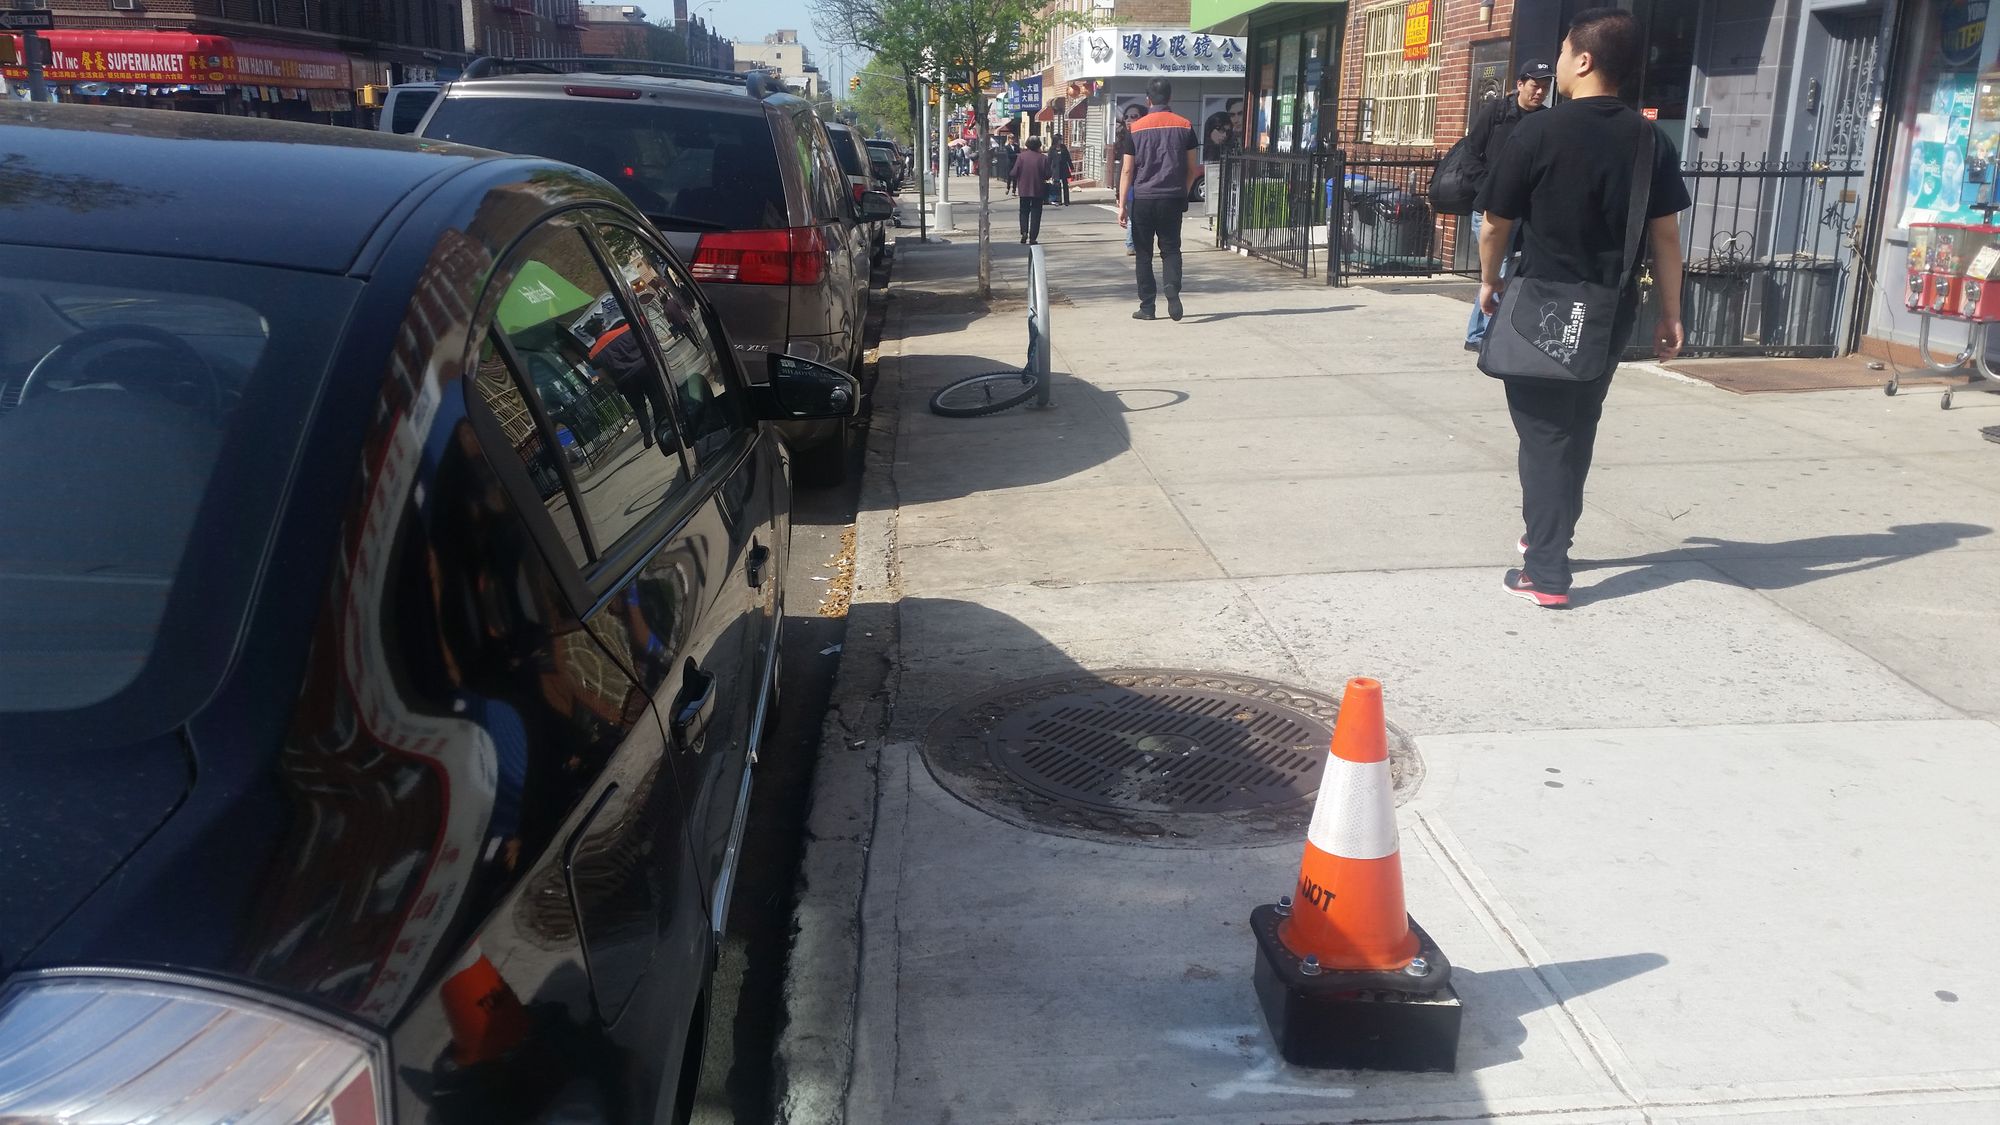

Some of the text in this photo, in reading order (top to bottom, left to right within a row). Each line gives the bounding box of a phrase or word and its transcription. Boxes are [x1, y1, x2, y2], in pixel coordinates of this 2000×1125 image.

[1417, 1, 1429, 15] RENT
[5, 15, 44, 25] ONE WAY
[65, 57, 79, 69] INC
[107, 53, 183, 72] SUPERMARKET
[1187, 63, 1200, 71] Vision
[298, 63, 336, 80] SUPERMARKET
[1302, 875, 1337, 913] DOT
